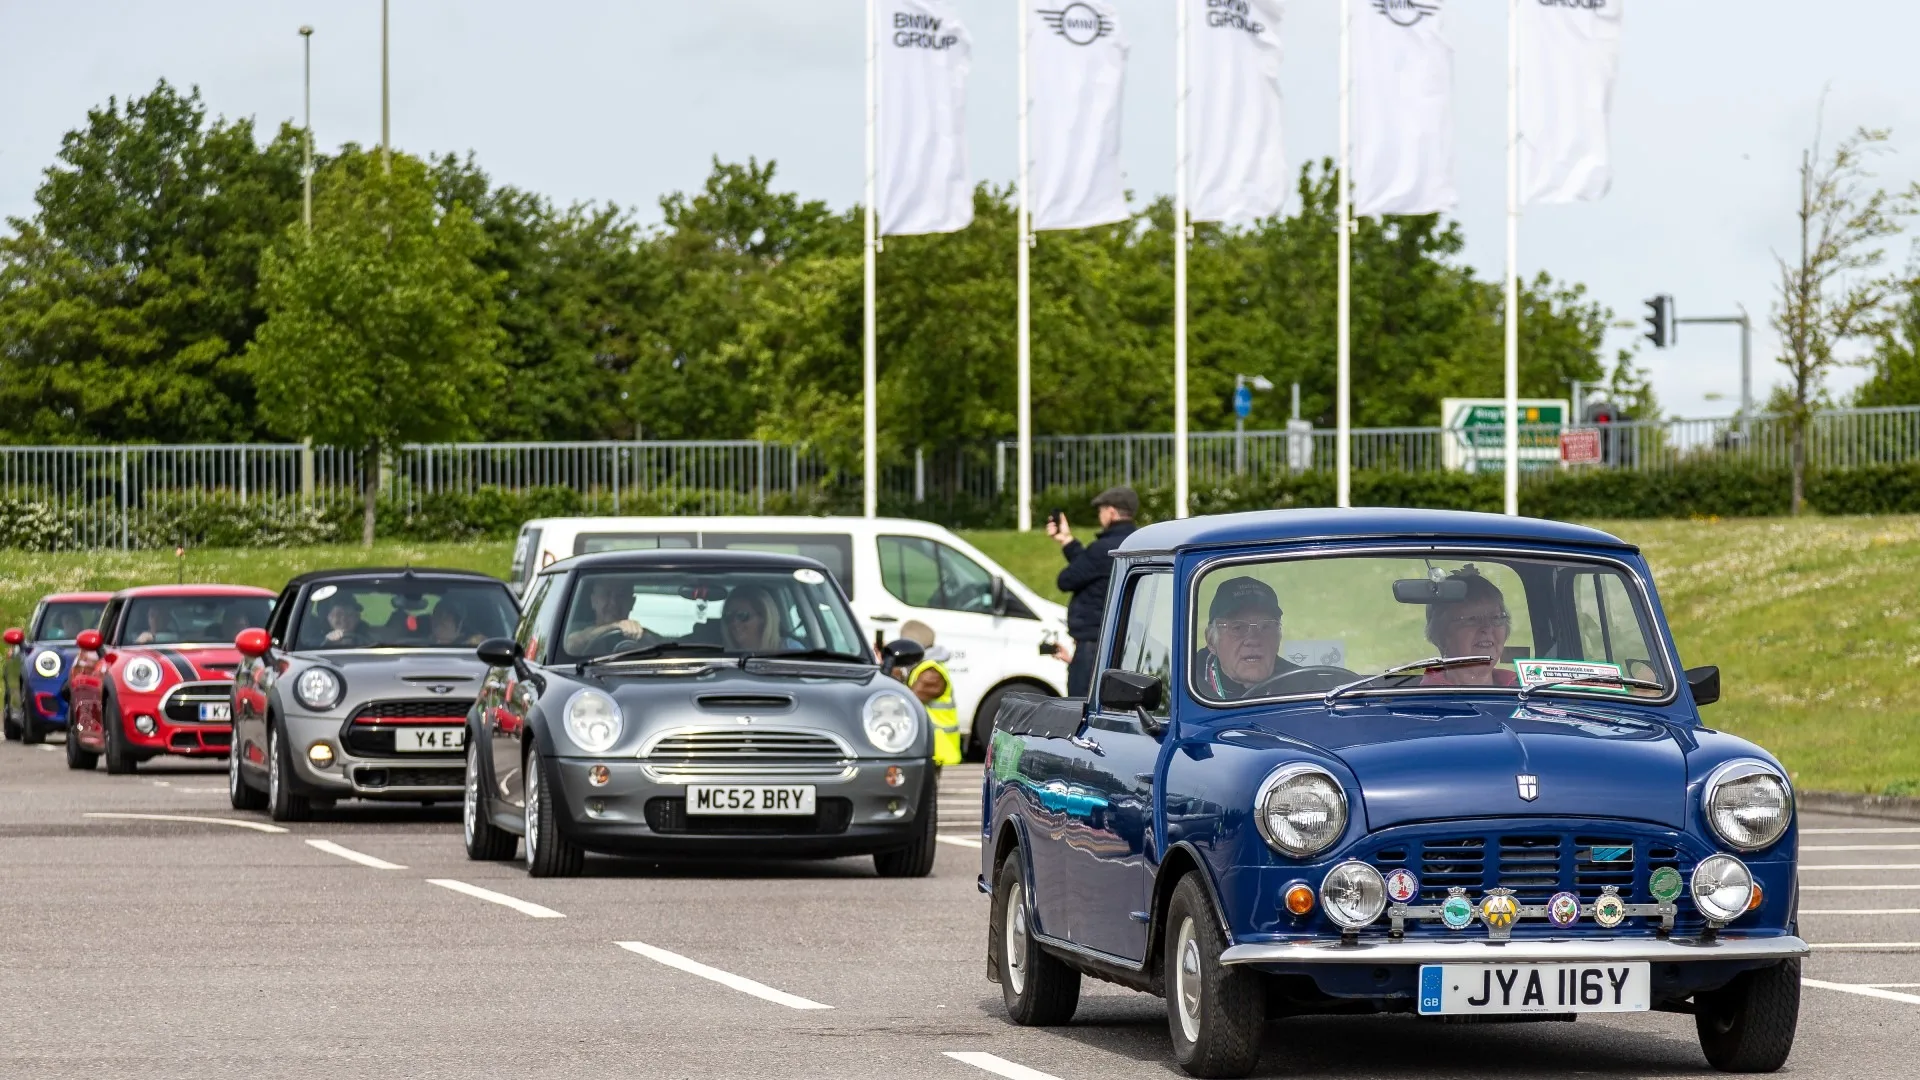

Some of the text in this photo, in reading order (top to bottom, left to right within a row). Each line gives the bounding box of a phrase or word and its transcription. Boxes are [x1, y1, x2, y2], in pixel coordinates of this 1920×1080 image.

[893, 12, 942, 31] BMW
[1066, 18, 1097, 29] MINI
[1206, 11, 1266, 34] GROUP
[893, 31, 958, 50] GROUP
[213, 705, 229, 717] K7
[416, 731, 464, 747] Y4 EJ
[697, 788, 804, 809] MC52 BRY
[1490, 896, 1511, 913] AA
[1467, 967, 1630, 1006] JYA 116Y
[1424, 998, 1439, 1007] GB
